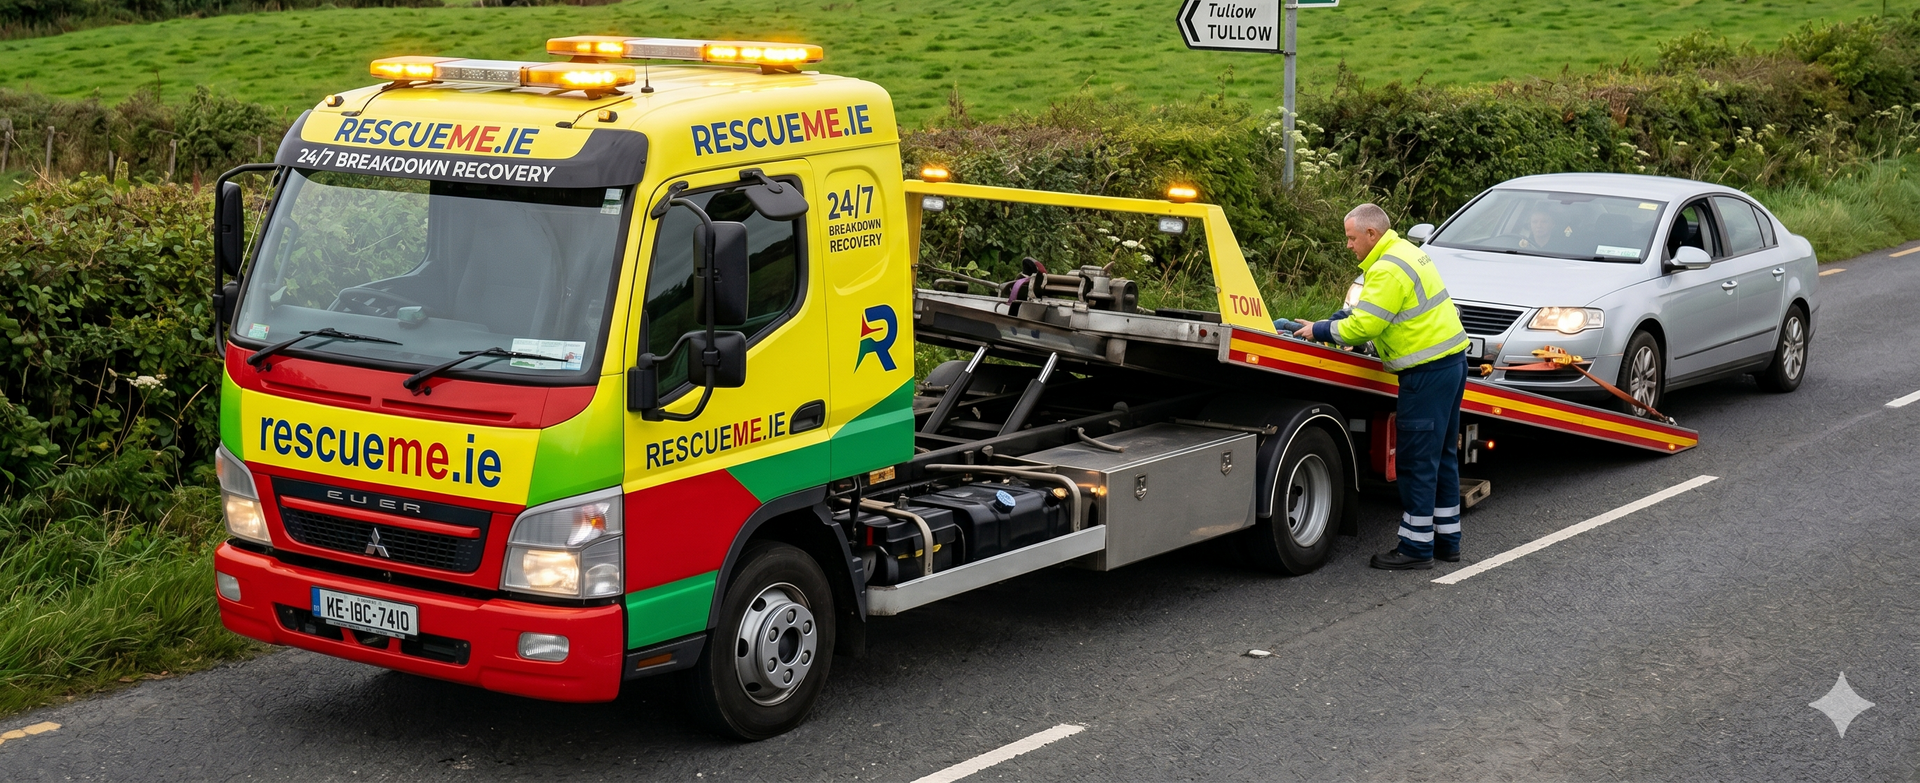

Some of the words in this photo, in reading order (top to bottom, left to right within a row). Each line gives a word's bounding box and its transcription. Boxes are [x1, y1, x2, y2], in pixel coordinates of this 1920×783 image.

[1207, 24, 1273, 41] TULLOW
[333, 118, 540, 155] RESCUEME.IE
[691, 104, 873, 156] RESCUEME.IE
[296, 147, 336, 167] 24/7
[335, 152, 451, 177] BREAKDOWN
[452, 161, 557, 183] RECOVERY
[827, 184, 874, 220] 24/7
[828, 218, 882, 236] BREAKDOWN
[829, 232, 883, 253] RECOVERY
[259, 416, 502, 488] rescueme.ie
[645, 411, 786, 470] RESCUEME.IE
[326, 490, 421, 514] EUER
